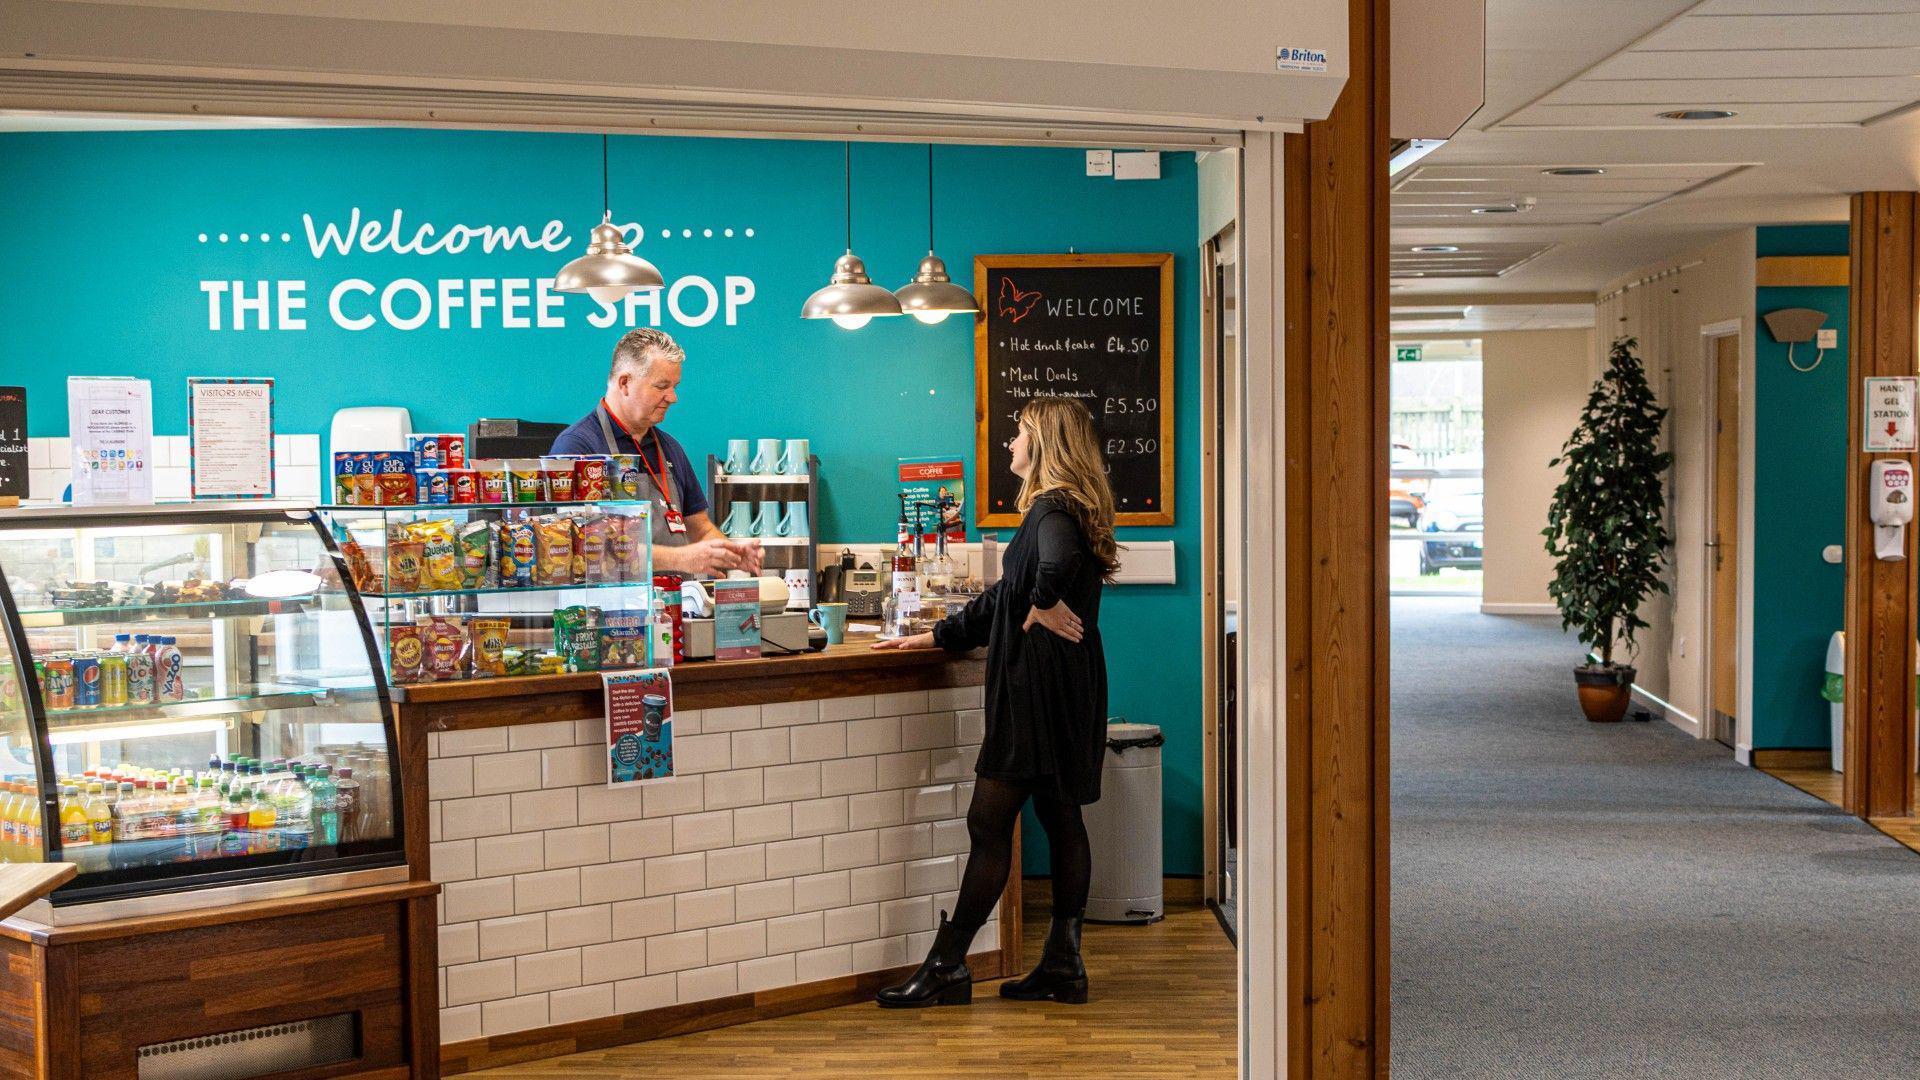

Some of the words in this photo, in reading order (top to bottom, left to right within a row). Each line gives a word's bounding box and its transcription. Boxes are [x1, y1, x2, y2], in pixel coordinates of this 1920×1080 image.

[1291, 49, 1325, 62] Briton
[303, 207, 572, 259] Welcome
[200, 280, 306, 330] THE
[329, 278, 565, 331] COFFEE
[1046, 297, 1143, 317] WELCOME
[1010, 337, 1031, 351] Hot
[1106, 336, 1149, 353] £4.50
[1009, 367, 1039, 382] Meal
[1046, 367, 1078, 382] Deals
[200, 389, 236, 397] VISITORS
[237, 389, 263, 397] MENU
[1105, 397, 1157, 414] £5.50
[1106, 438, 1157, 455] £2.50
[552, 479, 573, 490] POT
[163, 653, 181, 695] YAZOO
